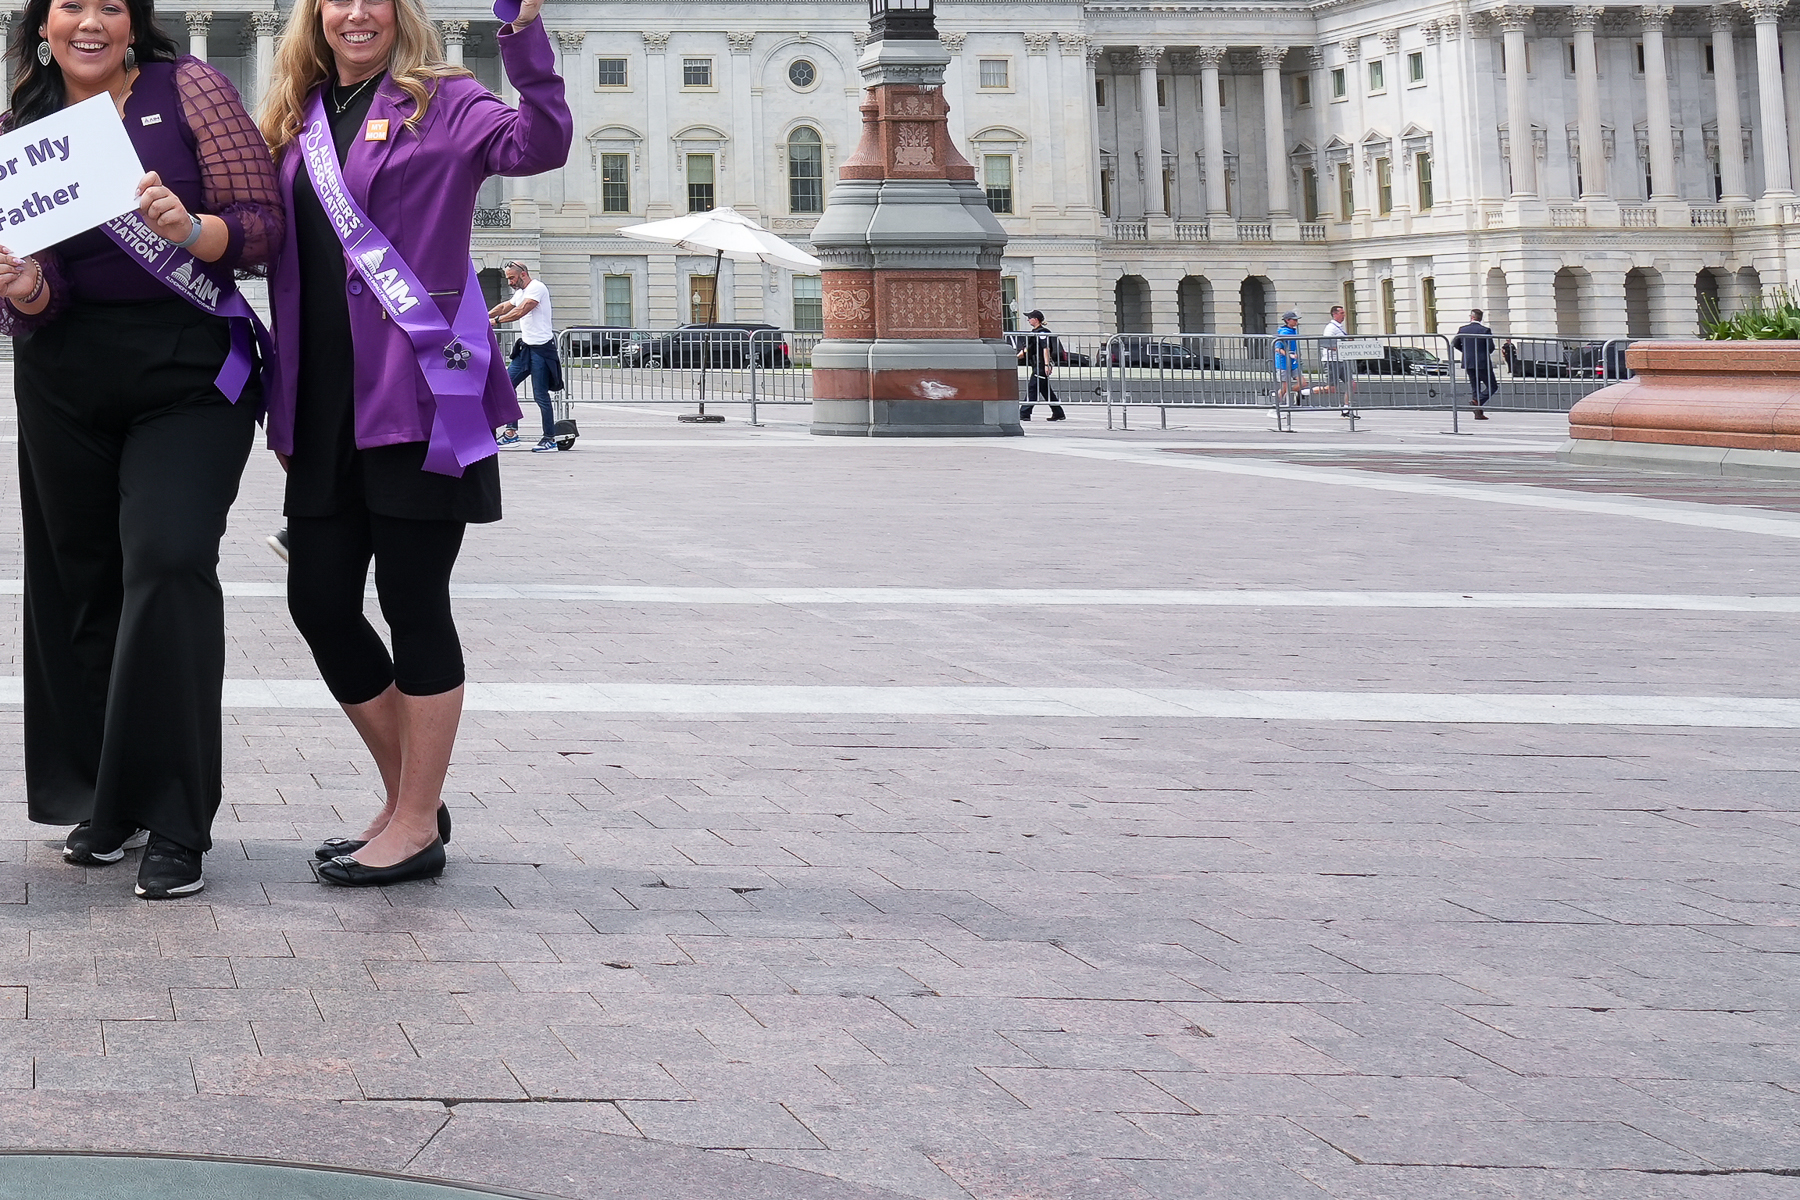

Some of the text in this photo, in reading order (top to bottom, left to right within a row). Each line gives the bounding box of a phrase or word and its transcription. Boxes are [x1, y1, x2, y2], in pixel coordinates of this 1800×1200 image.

[371, 123, 383, 131] MY
[24, 135, 70, 166] My
[309, 150, 353, 239] ASSOCIATION
[319, 144, 360, 230] ALZHEIMER'S
[106, 218, 159, 263] IATION
[119, 212, 167, 251] IMER'S
[188, 273, 220, 307] AIM
[373, 268, 419, 314] AIM
